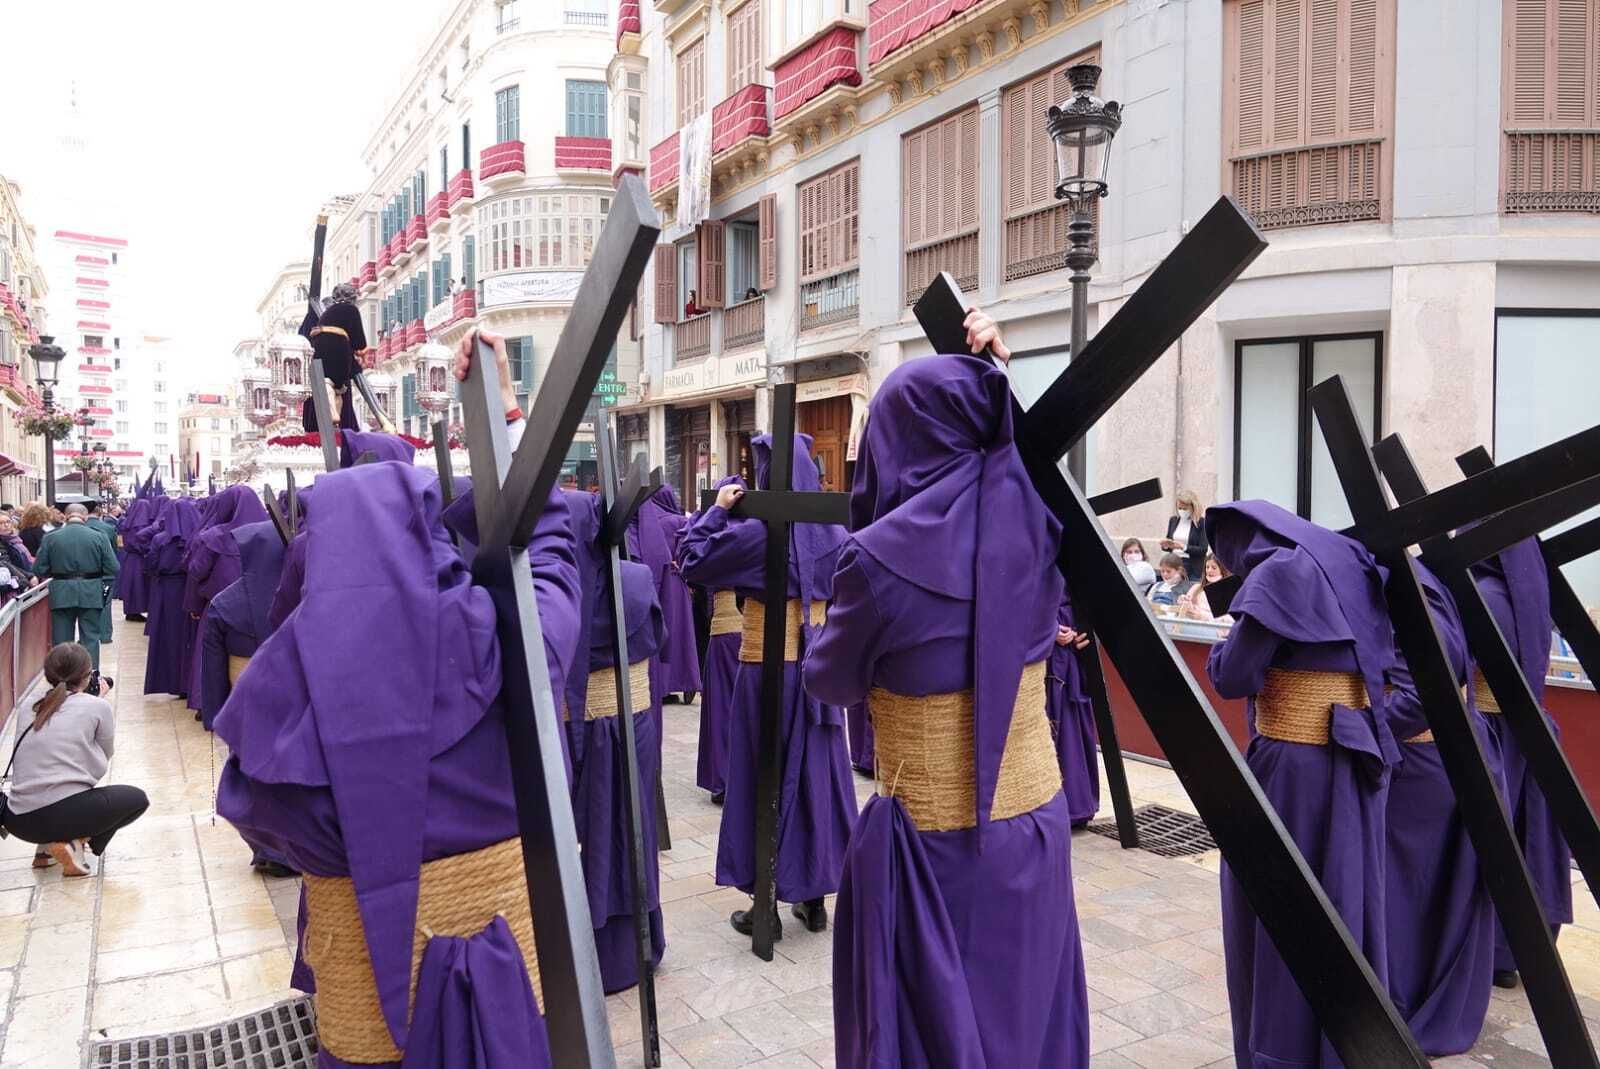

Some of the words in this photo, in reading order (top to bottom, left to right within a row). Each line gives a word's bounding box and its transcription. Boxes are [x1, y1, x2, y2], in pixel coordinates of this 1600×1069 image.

[521, 279, 549, 287] APERTURA
[665, 372, 695, 389] FARMACIA
[735, 357, 760, 377] MATA
